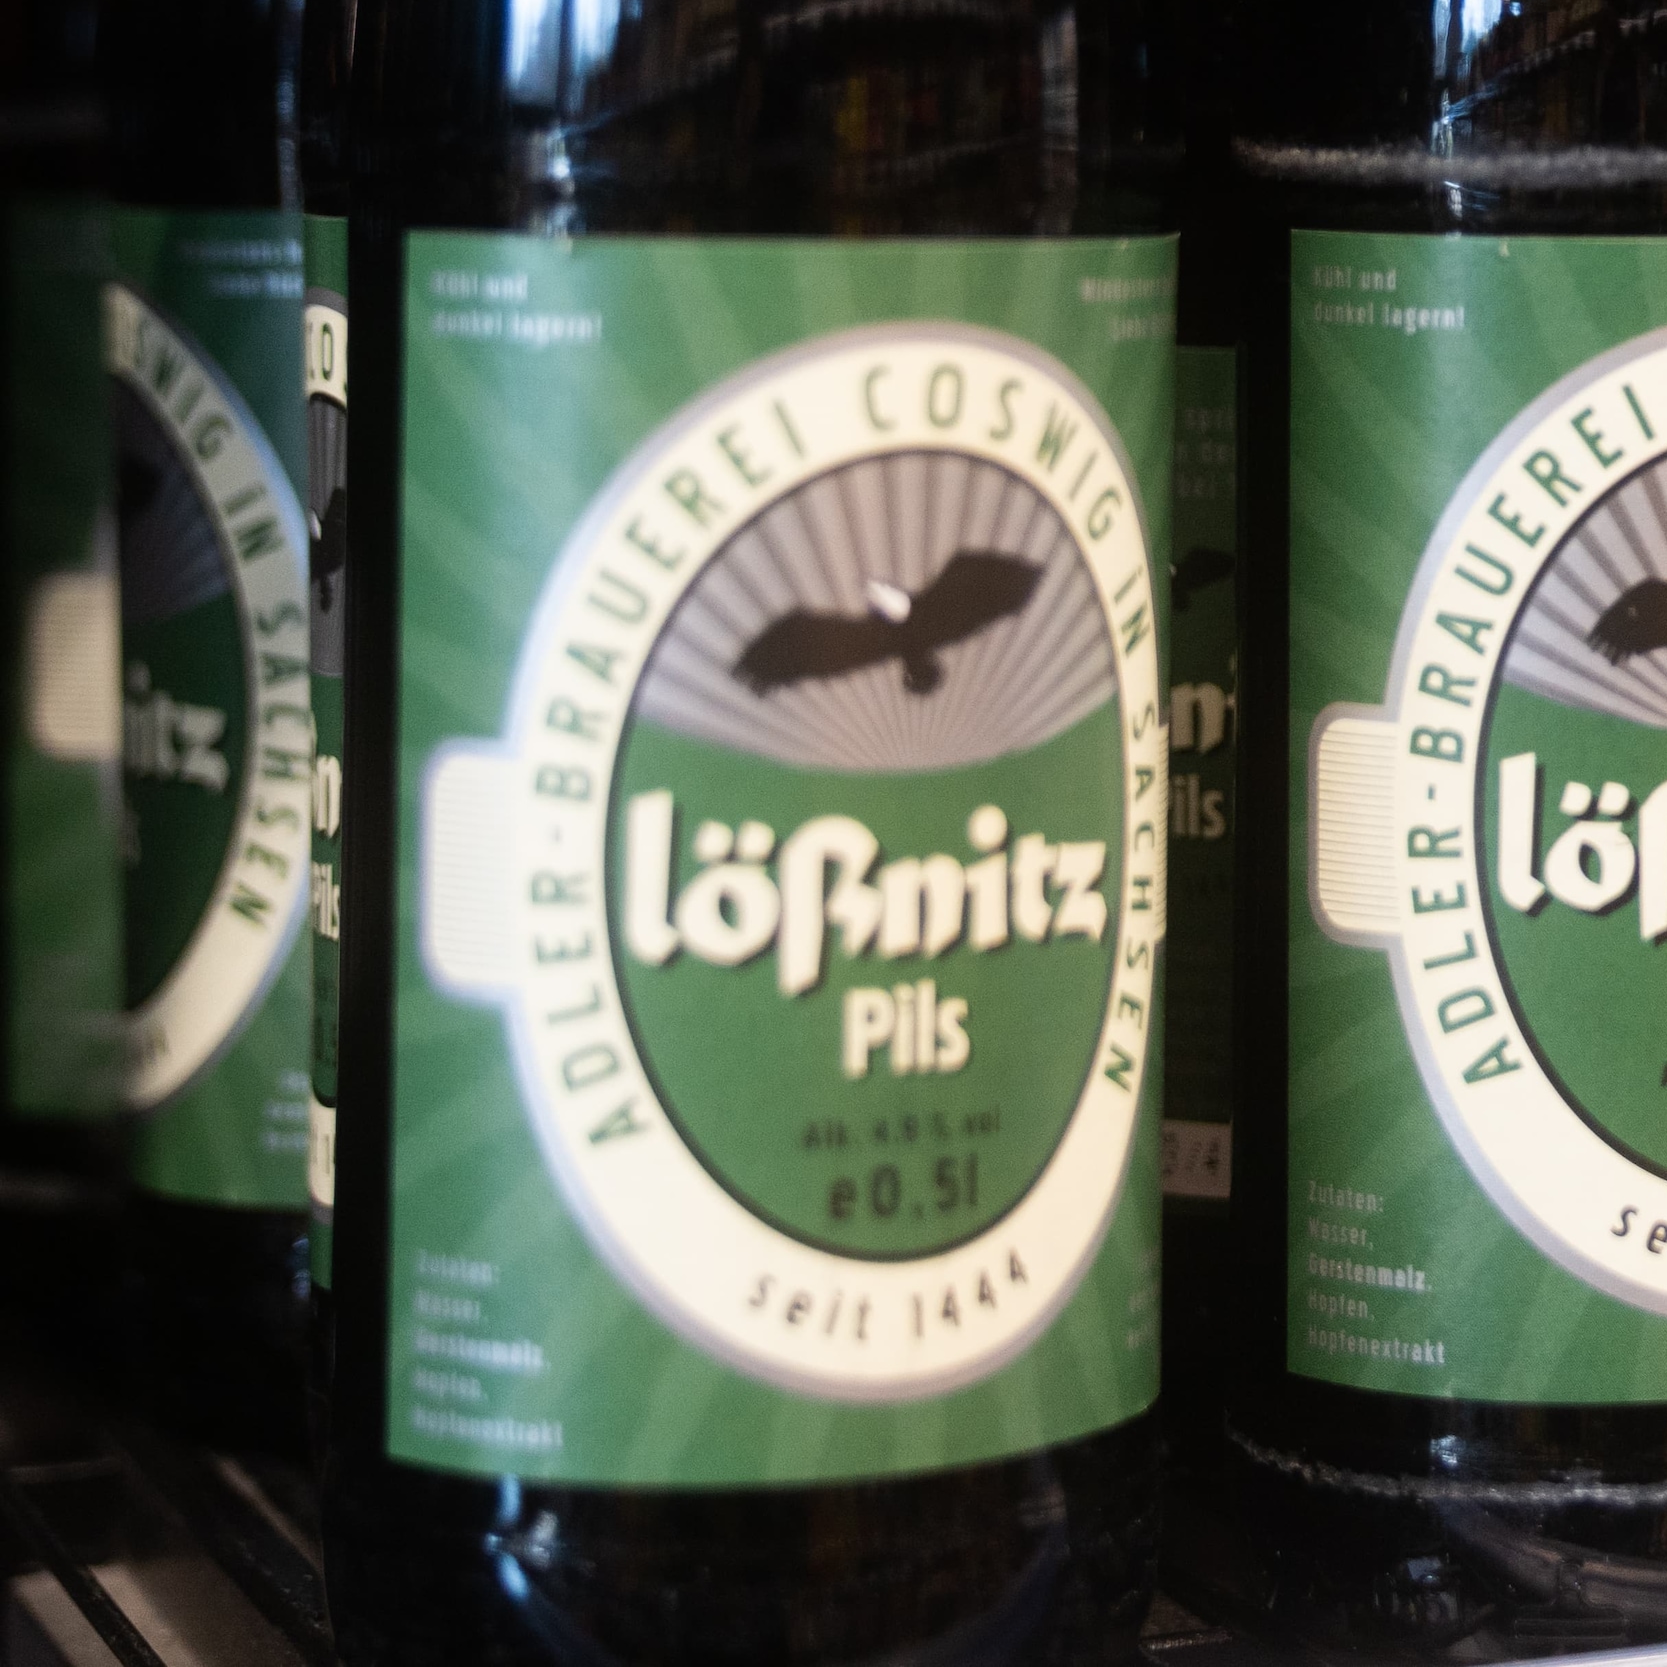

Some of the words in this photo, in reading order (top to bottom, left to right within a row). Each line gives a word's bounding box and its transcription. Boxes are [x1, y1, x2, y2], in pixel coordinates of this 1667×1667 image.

[1360, 268, 1397, 291] und
[529, 398, 809, 1149] ADLER-BRAUEREI
[862, 363, 1115, 542] COSWIG
[1104, 702, 1156, 1092] SACHSEN
[1406, 382, 1657, 1086] ADLER-BRAUEREI
[624, 789, 1108, 996] lößnitz
[844, 981, 970, 1079] Pils
[749, 1274, 872, 1341] seit
[913, 1246, 1029, 1338] 1444
